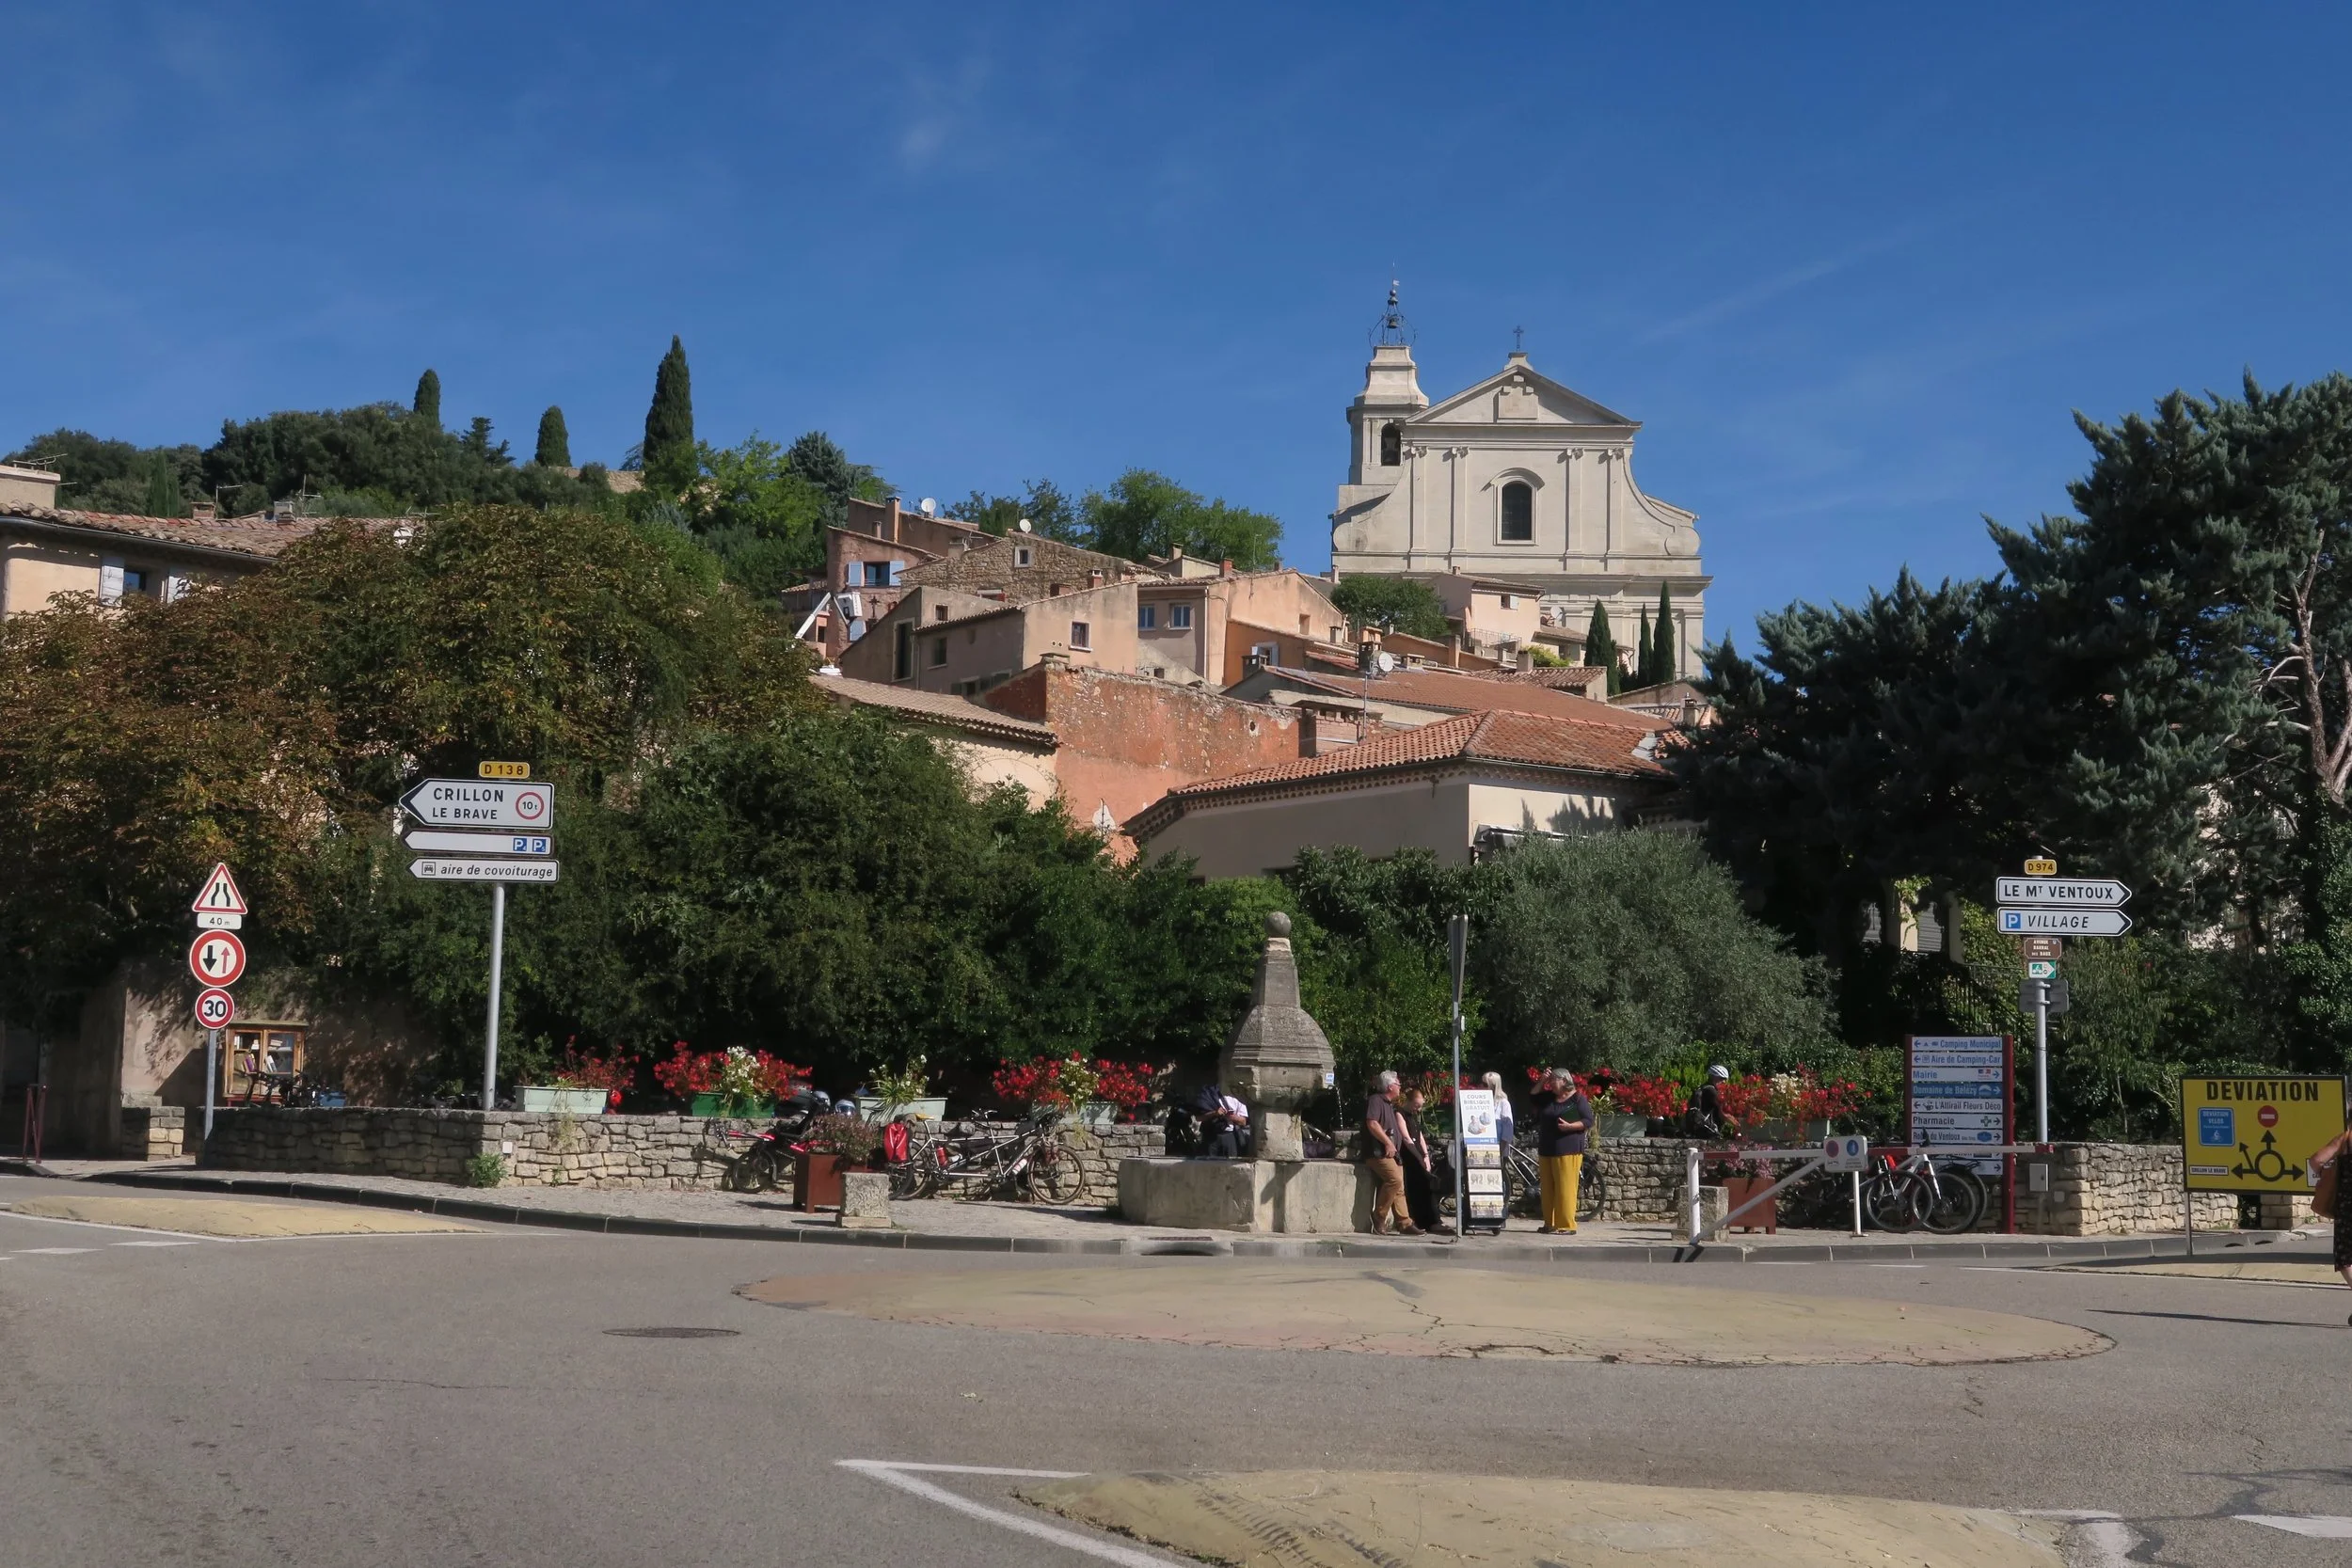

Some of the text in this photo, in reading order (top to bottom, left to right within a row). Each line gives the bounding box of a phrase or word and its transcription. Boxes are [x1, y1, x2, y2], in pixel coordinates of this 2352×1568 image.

[485, 765, 524, 775] D 138
[434, 787, 503, 802] CRILLON
[433, 807, 498, 820] LE BRAVE
[440, 864, 553, 879] aire de covoiturage
[2004, 885, 2020, 897] LE
[2048, 886, 2113, 899] VENTOUX
[2008, 914, 2090, 928] P VILLAGE
[203, 1000, 227, 1018] 30
[1940, 1039, 2001, 1049] Camping Municipal
[1957, 1055, 2000, 1065] Camping-Car
[1913, 1070, 1938, 1079] Mairie
[1913, 1085, 1943, 1094] Domaine
[1945, 1085, 1953, 1094] de
[2206, 1082, 2319, 1101] DEVIATION
[1913, 1117, 1955, 1125] Pharmacie
